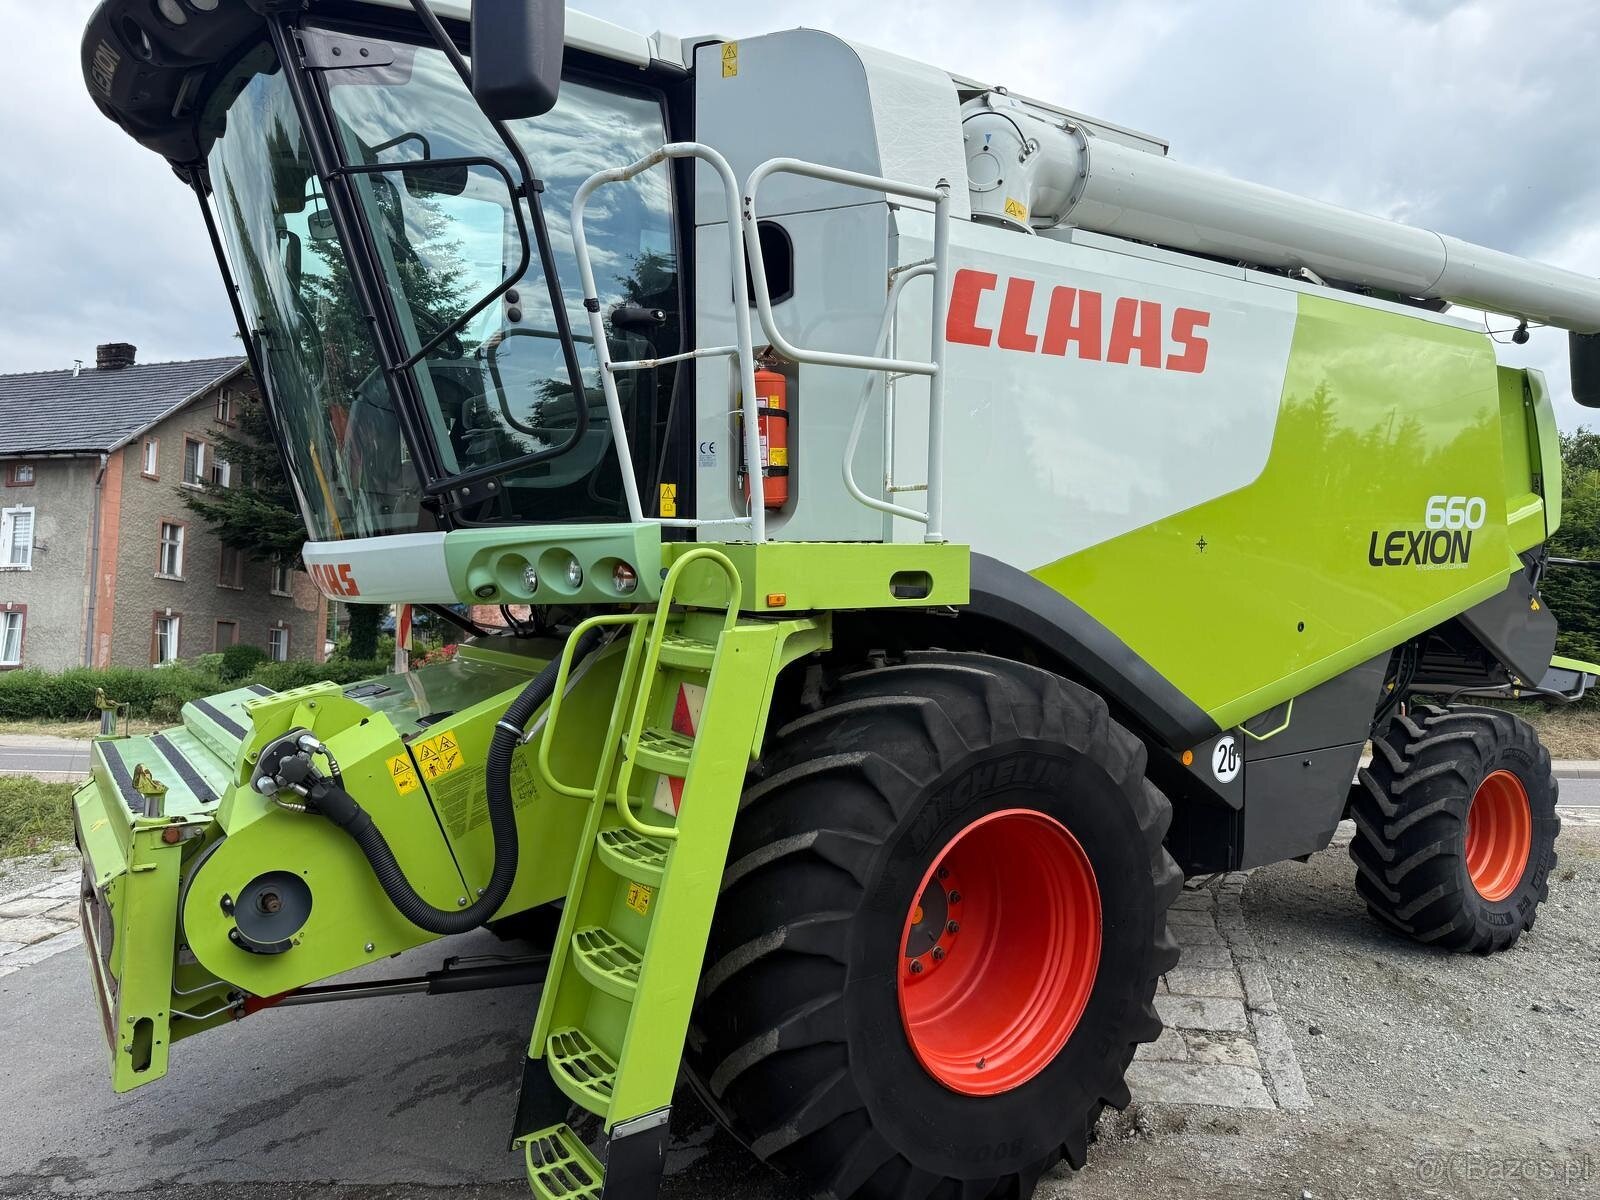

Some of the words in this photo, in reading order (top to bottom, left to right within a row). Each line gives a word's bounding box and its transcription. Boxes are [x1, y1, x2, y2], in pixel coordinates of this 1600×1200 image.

[946, 268, 1211, 373] CLAAS
[1425, 495, 1486, 530] 660
[1368, 530, 1472, 567] LEXION
